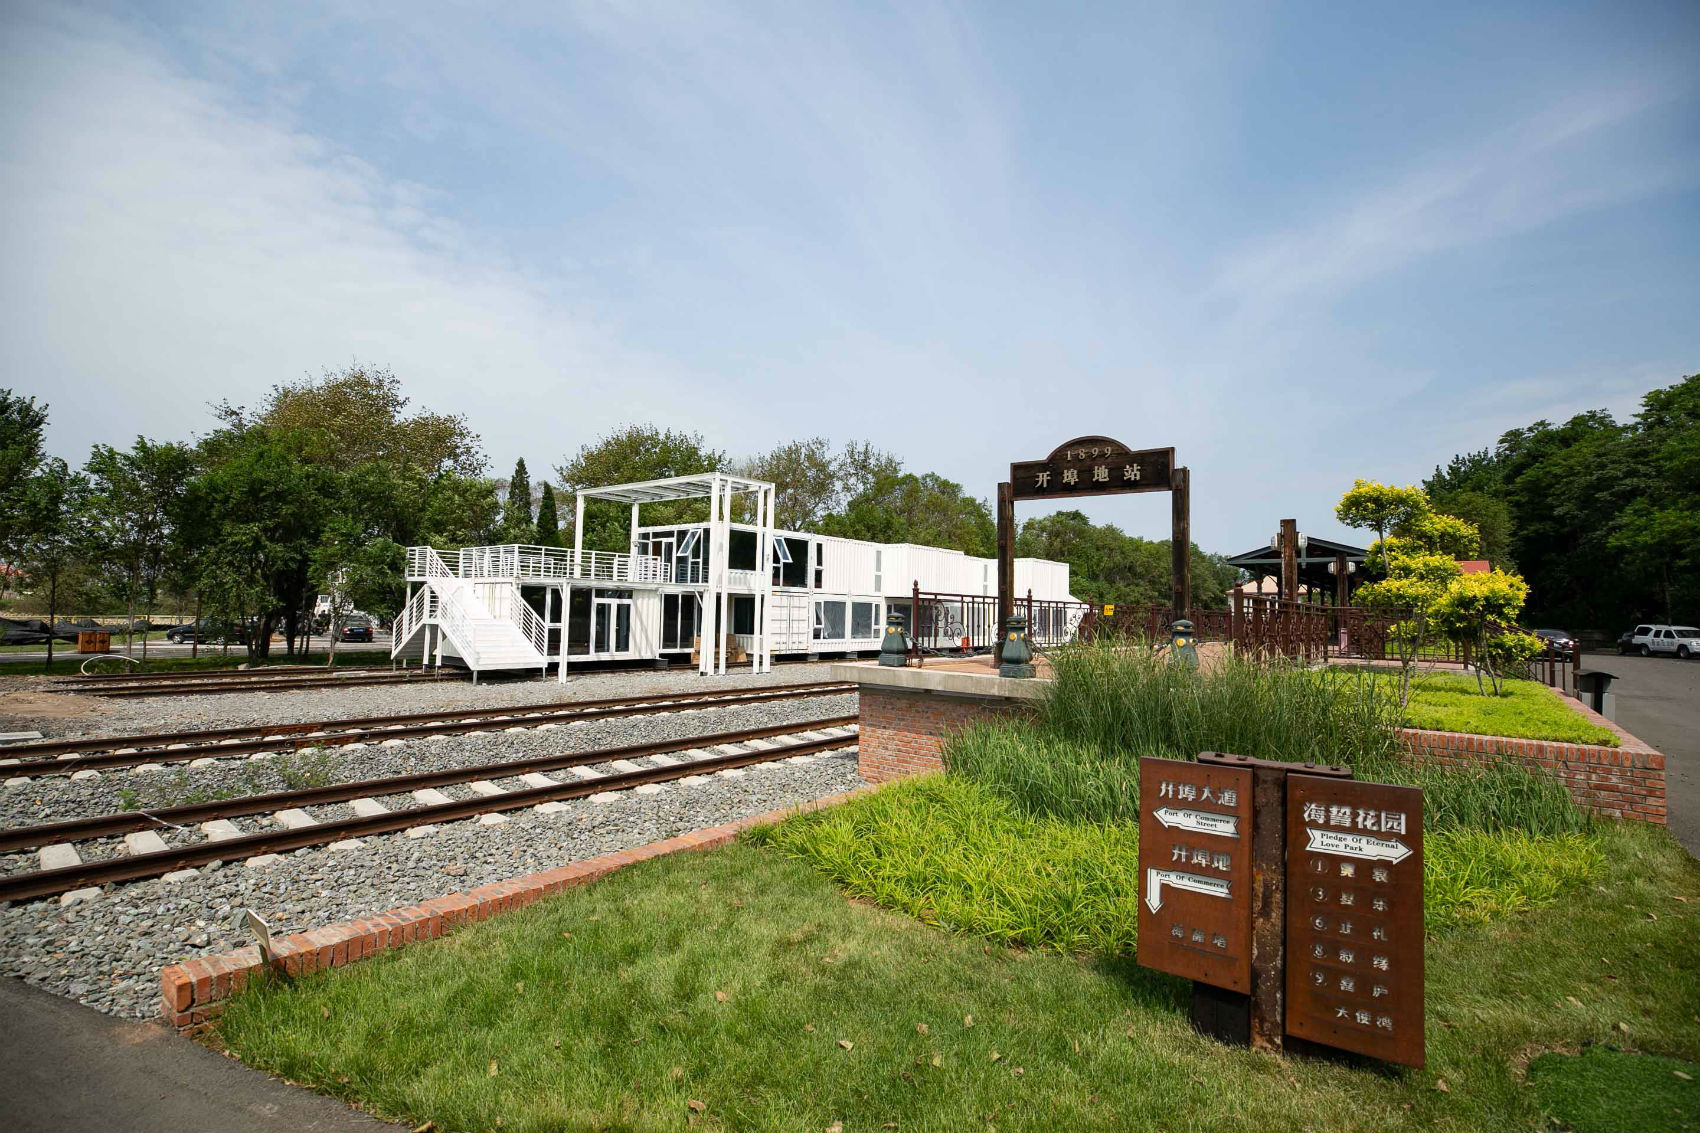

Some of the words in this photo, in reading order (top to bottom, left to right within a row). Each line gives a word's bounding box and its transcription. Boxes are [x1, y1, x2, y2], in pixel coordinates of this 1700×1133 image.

[1066, 446, 1112, 461] 1899
[1034, 463, 1141, 488] 开埠地站
[1164, 809, 1178, 818] Port
[1183, 811, 1192, 819] Of
[1195, 814, 1231, 825] Commerce
[1196, 820, 1218, 829] Street
[1303, 801, 1406, 835] 海誓花园
[1320, 832, 1348, 842] Pledge
[1351, 836, 1363, 844] Of
[1366, 838, 1399, 850] Eternal
[1320, 840, 1340, 849] Love
[1344, 844, 1364, 852] Park
[1171, 843, 1232, 872] 开埠地
[1156, 871, 1171, 879] Port
[1187, 877, 1225, 889] Commerce
